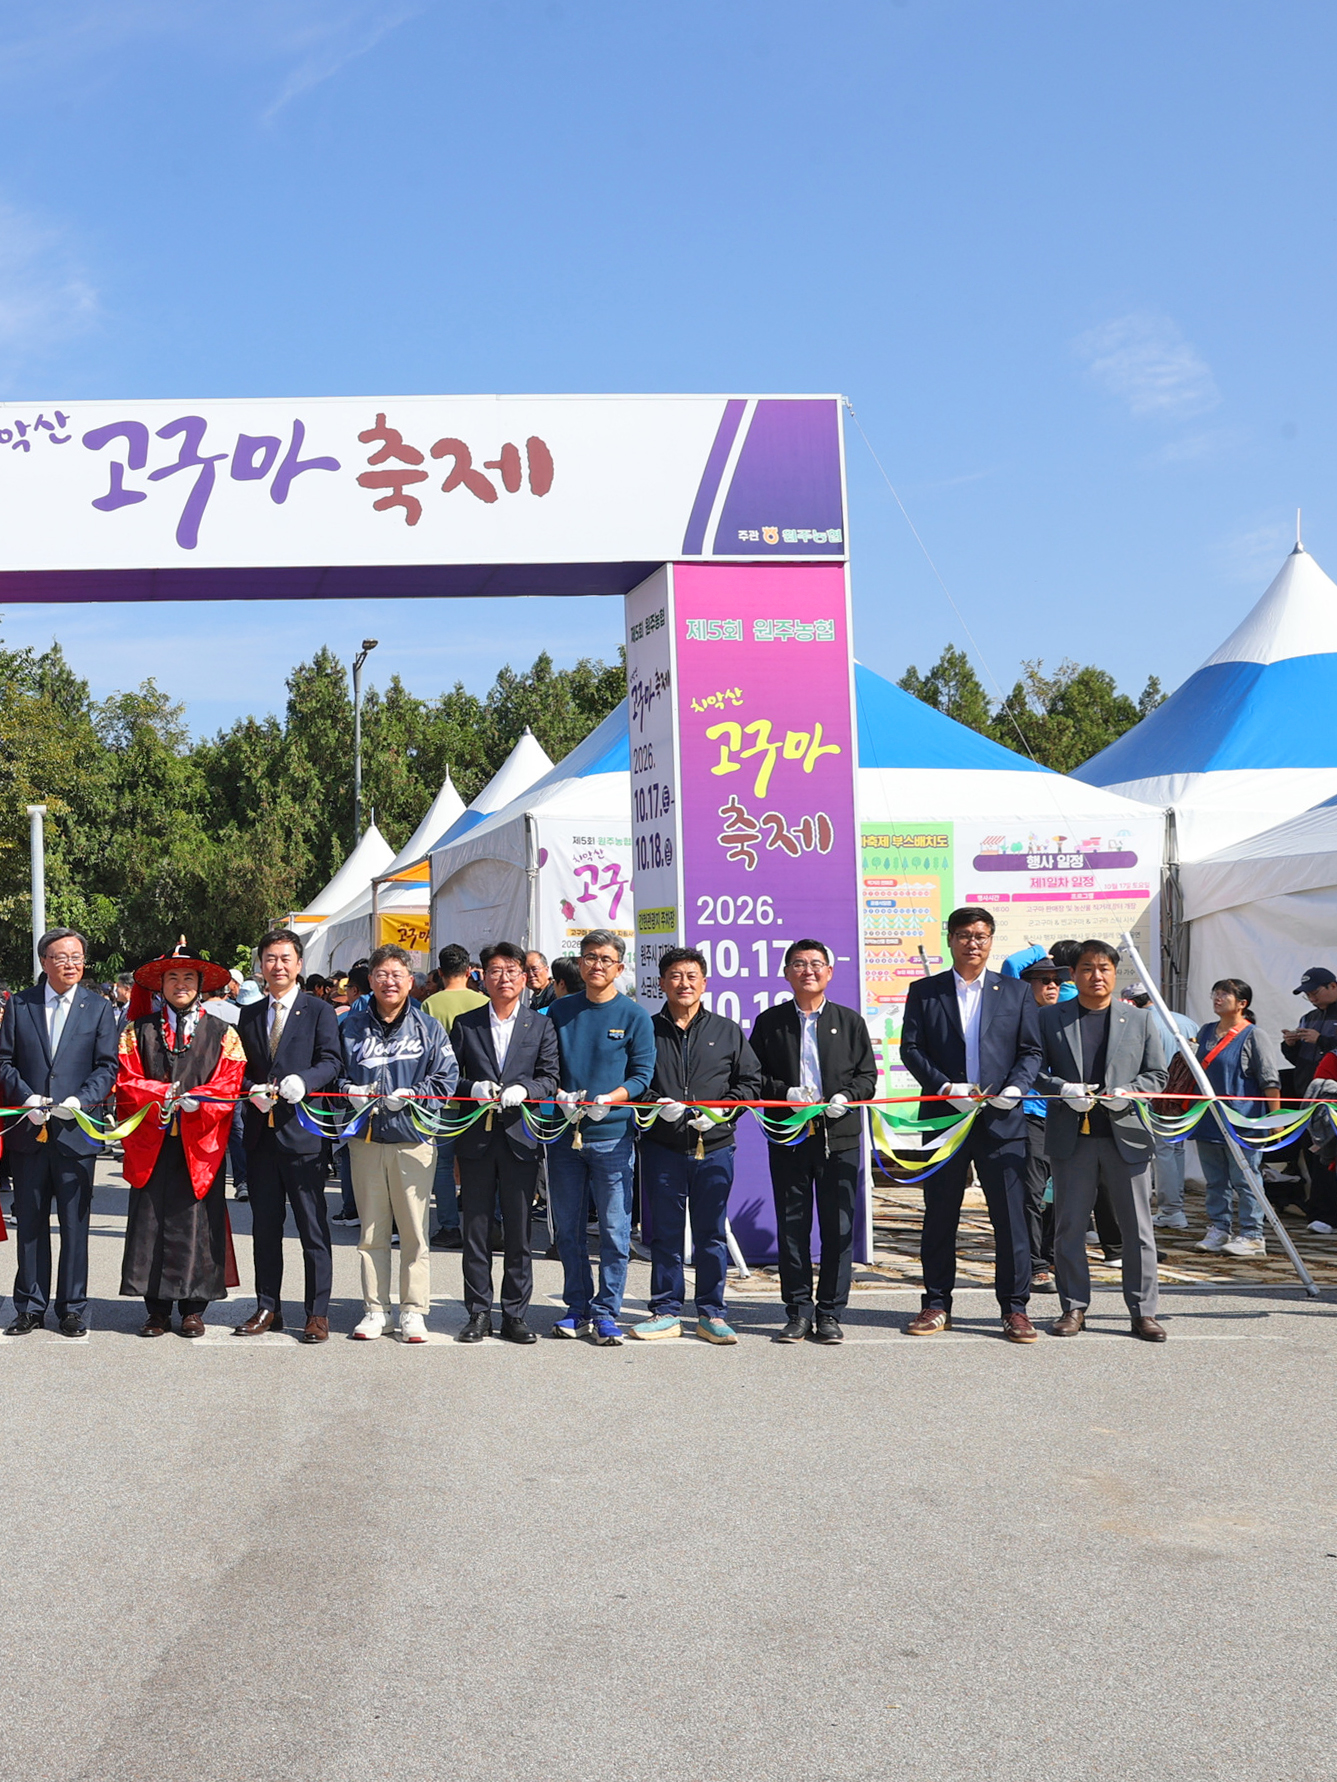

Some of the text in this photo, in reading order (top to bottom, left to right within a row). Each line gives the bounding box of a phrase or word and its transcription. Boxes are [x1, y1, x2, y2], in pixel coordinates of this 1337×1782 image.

[82, 415, 341, 550] 고구마
[356, 413, 554, 526] 축제
[738, 529, 842, 544] 주관 원주농협
[686, 619, 835, 642] 제5회 원주농협
[690, 687, 744, 712] 치악산
[705, 719, 841, 798] 고구마
[572, 836, 595, 845] 제5회
[718, 795, 834, 871] 축제
[892, 835, 949, 848] 부스배치도
[573, 848, 604, 863] 치악산
[1026, 854, 1084, 869] 행사 일정
[573, 863, 634, 920] 고구
[1030, 875, 1095, 889] 제1일차 일정
[696, 896, 784, 925] 2026.
[353, 1036, 423, 1062] Wonju
